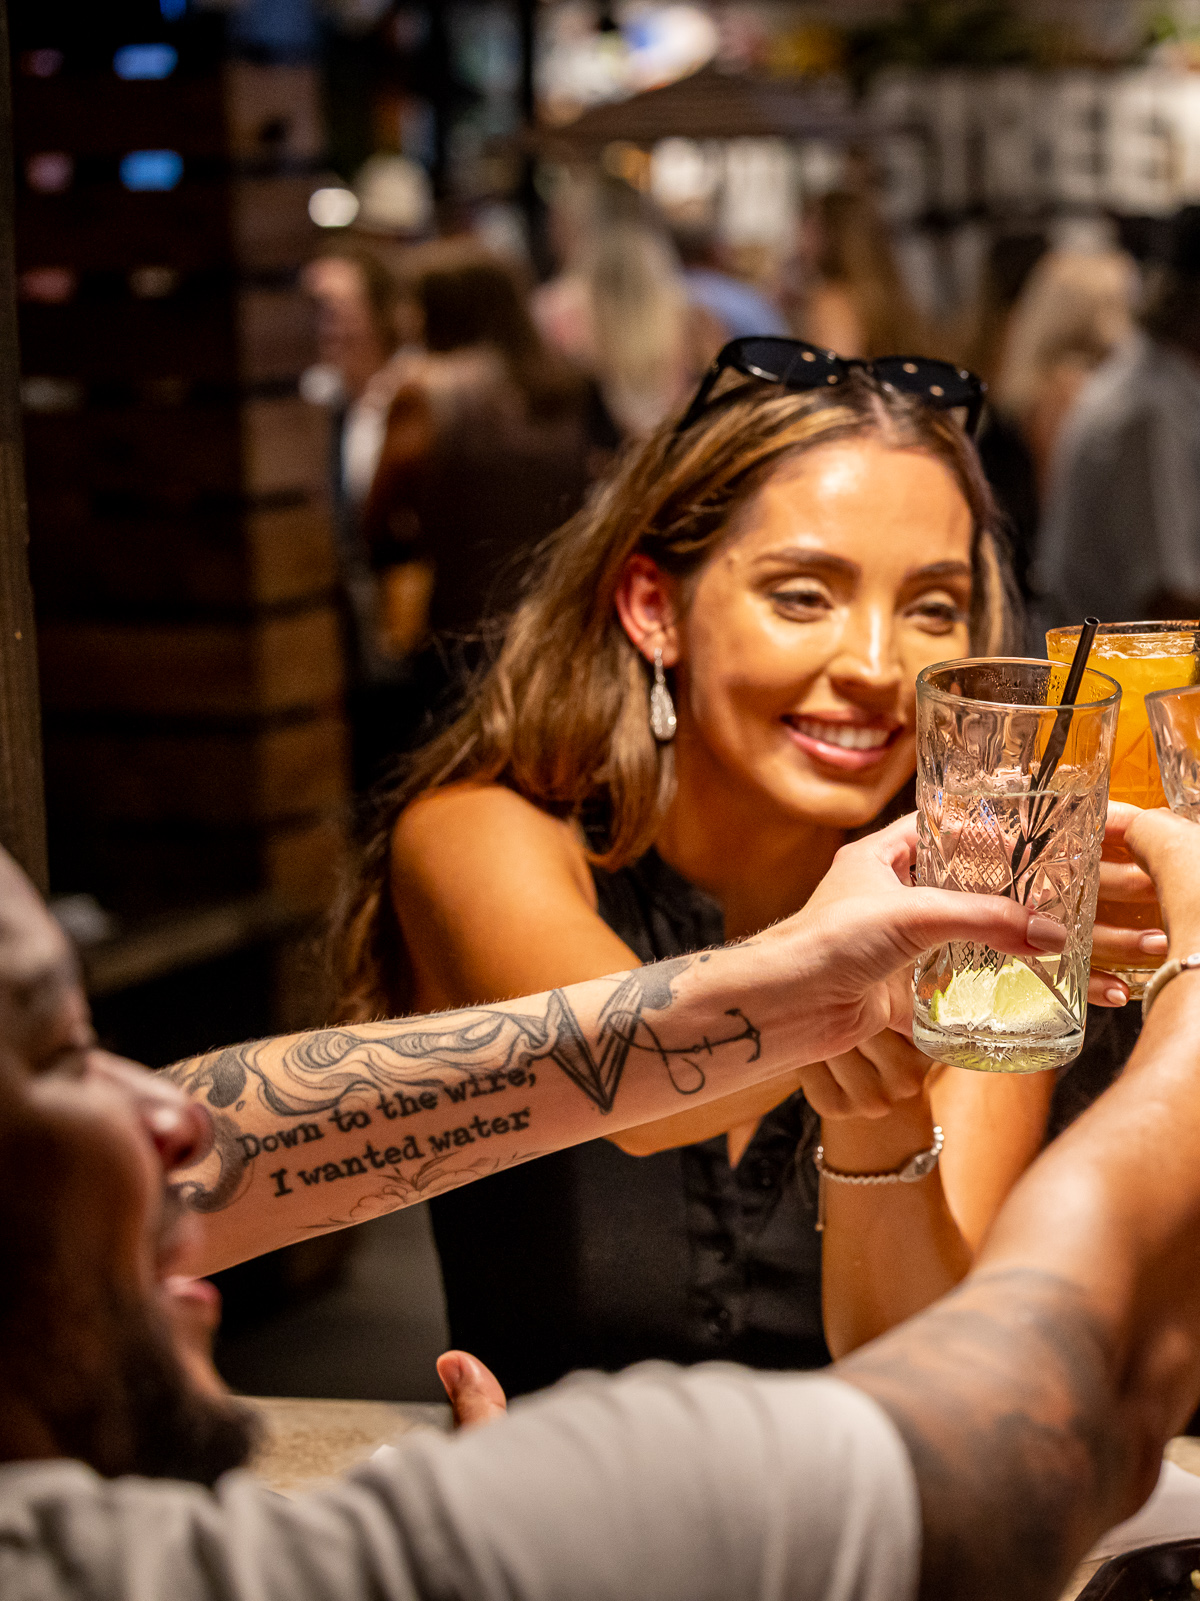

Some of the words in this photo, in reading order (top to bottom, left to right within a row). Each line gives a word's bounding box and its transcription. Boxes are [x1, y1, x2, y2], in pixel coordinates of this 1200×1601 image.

[236, 1122, 325, 1167] Down
[328, 1107, 372, 1133] to
[376, 1090, 439, 1120] the
[270, 1167, 294, 1198] I
[297, 1134, 425, 1186] wanted
[428, 1106, 531, 1152] water
